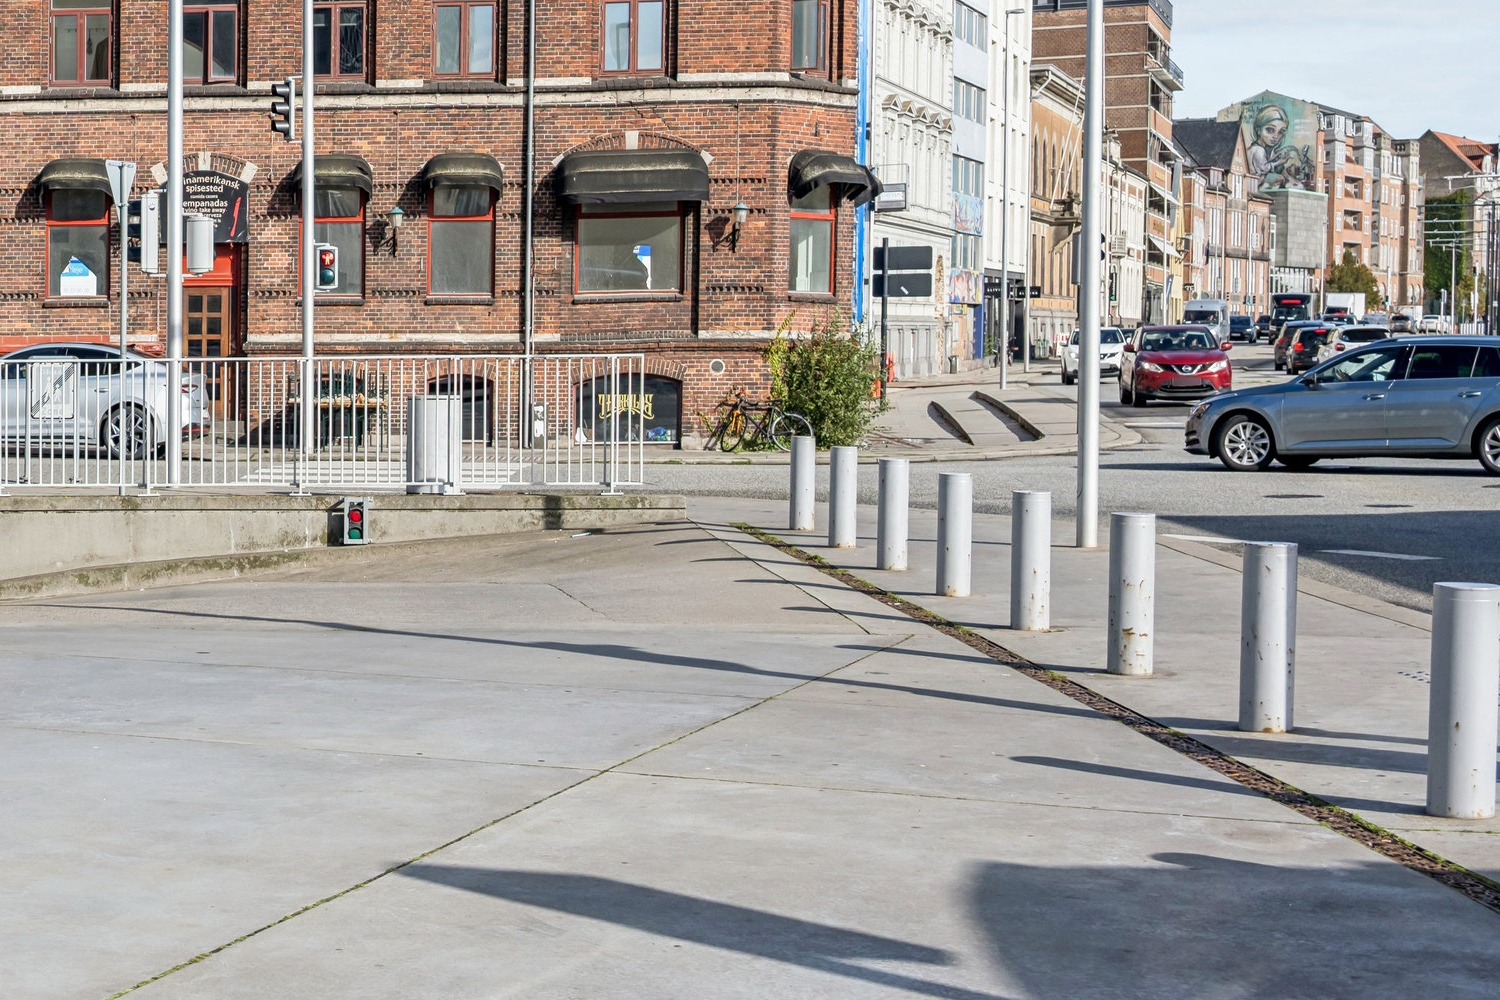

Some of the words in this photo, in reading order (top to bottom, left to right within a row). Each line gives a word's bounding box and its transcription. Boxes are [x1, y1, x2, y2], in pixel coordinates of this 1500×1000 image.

[183, 176, 241, 190] inamerikansk
[185, 184, 224, 193] spisested
[183, 199, 228, 209] empanadas
